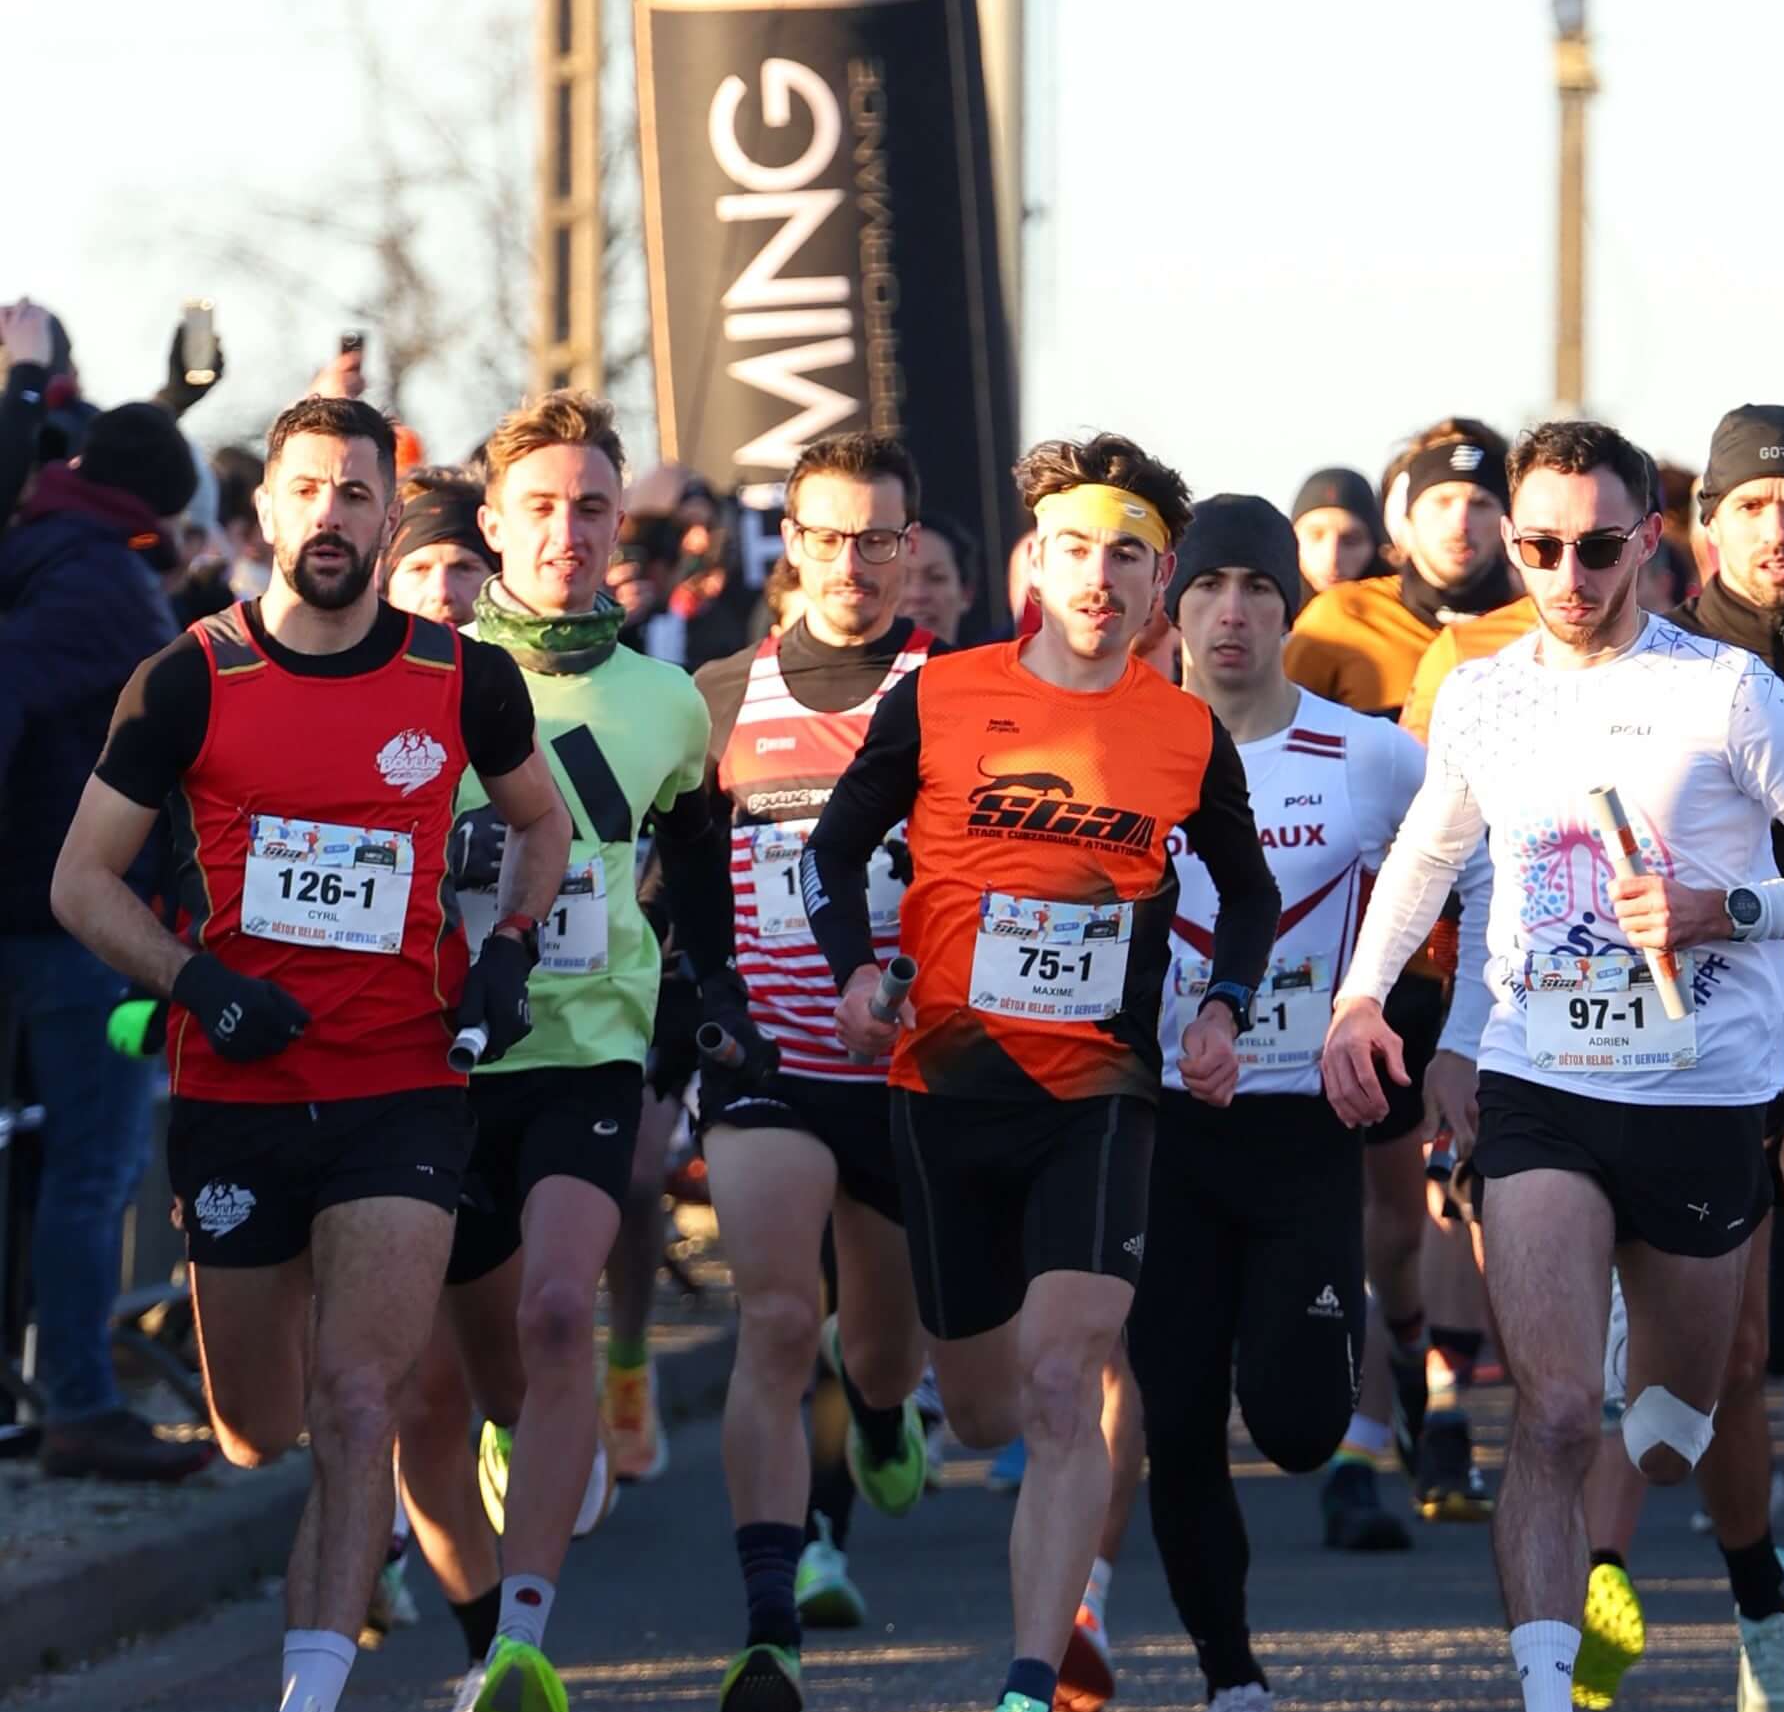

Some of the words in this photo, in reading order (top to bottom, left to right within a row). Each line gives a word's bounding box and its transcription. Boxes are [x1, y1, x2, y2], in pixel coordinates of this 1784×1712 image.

[1284, 794, 1322, 808] POLI
[968, 827, 1004, 839] STADE
[278, 868, 376, 909] 126-1
[308, 909, 340, 922] CYRIL
[1018, 946, 1093, 982] 75-1
[1032, 985, 1074, 997] MAXIME
[1569, 998, 1644, 1030] 97-1
[1589, 1036, 1630, 1047] ADRIEN
[1558, 1051, 1583, 1066] DÉTOX
[1586, 1053, 1614, 1067] RELAIS
[1622, 1054, 1632, 1066] ST
[1634, 1052, 1670, 1066] GERVAIS
